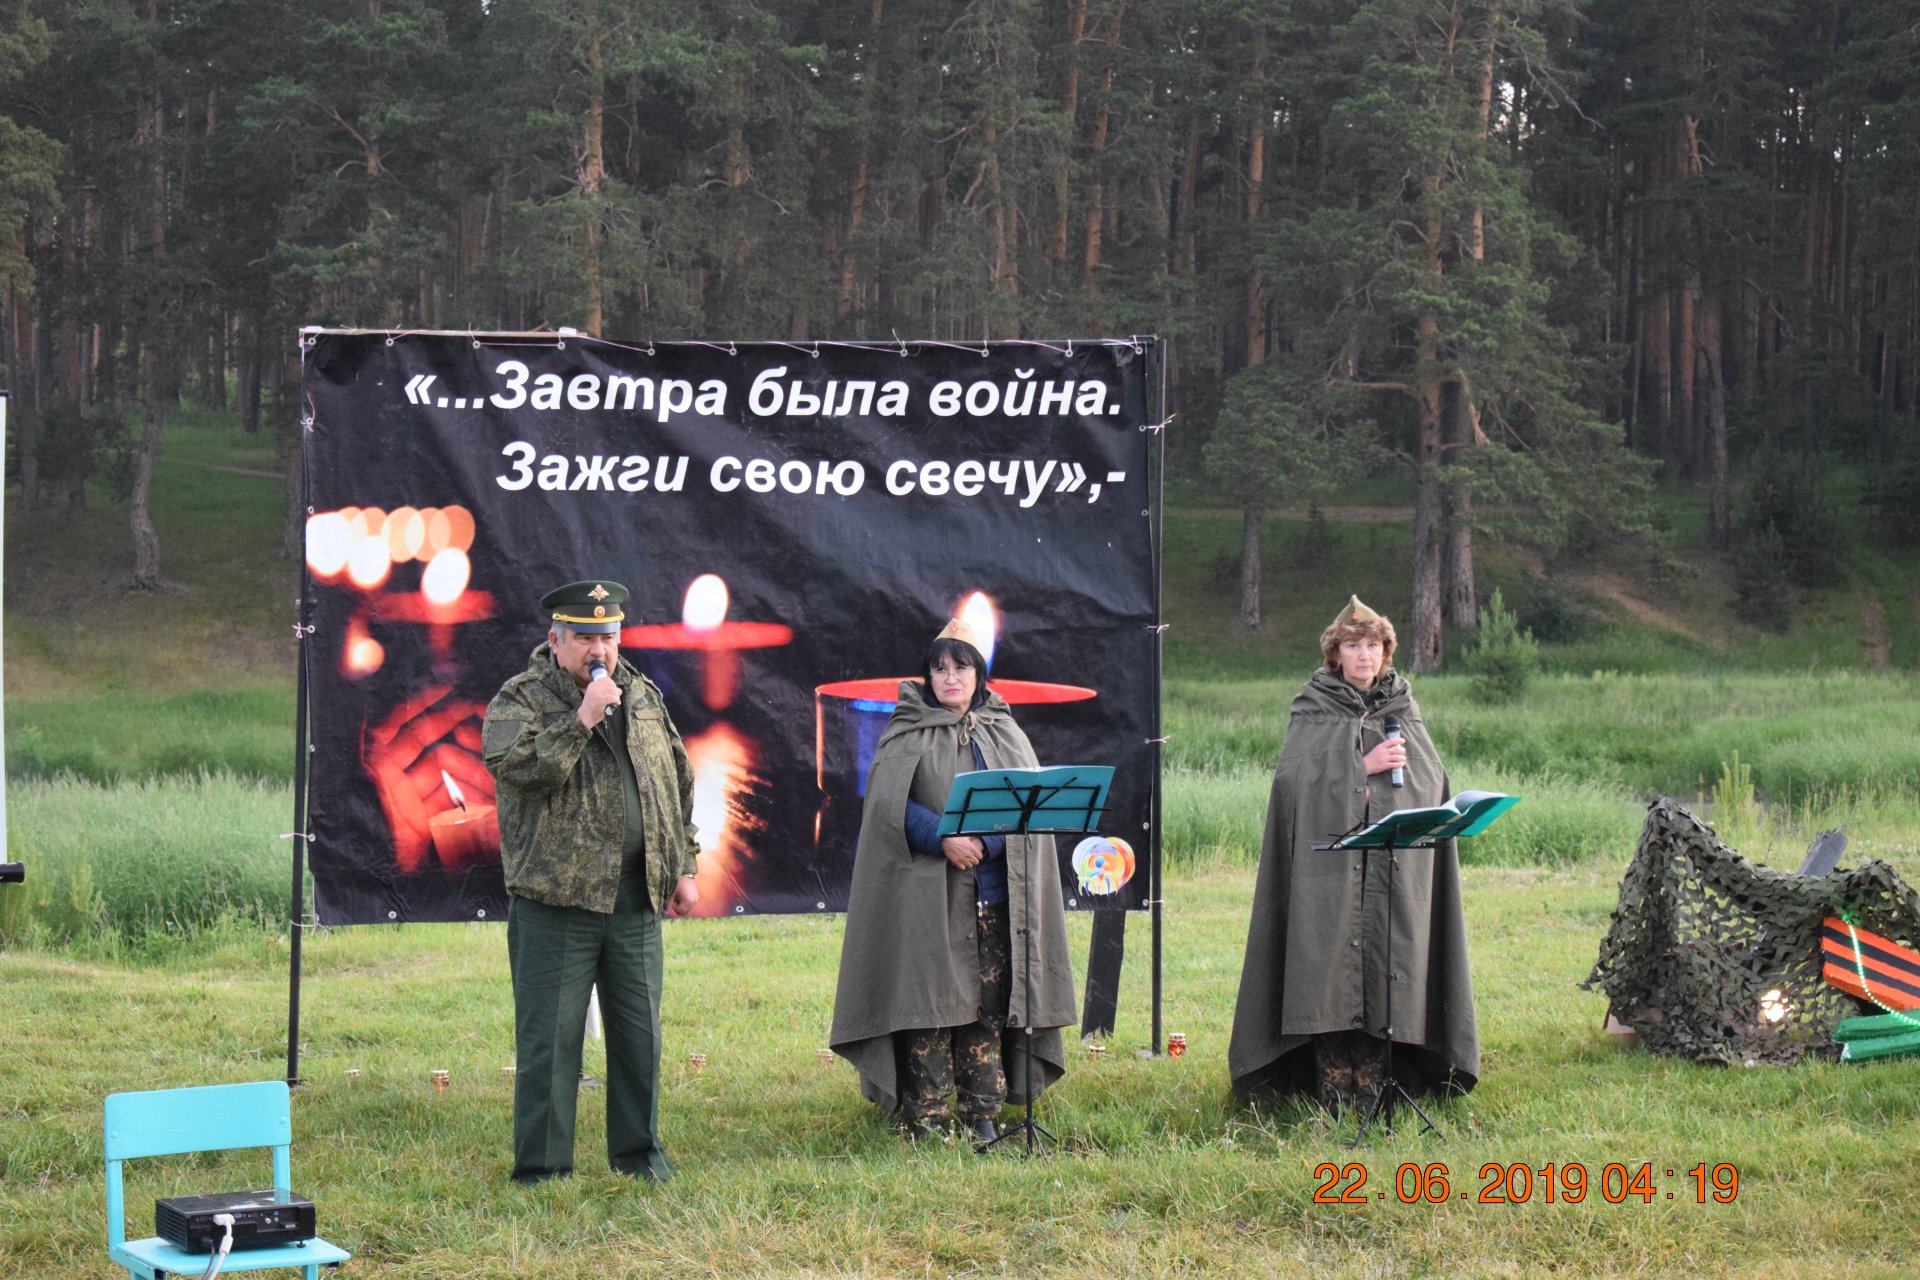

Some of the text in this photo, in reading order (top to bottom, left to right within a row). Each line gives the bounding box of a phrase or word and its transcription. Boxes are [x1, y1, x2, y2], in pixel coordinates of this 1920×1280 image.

[748, 365, 910, 417] была
[929, 368, 1121, 417] война.
[495, 440, 690, 494] Зажги
[709, 455, 865, 497] свою
